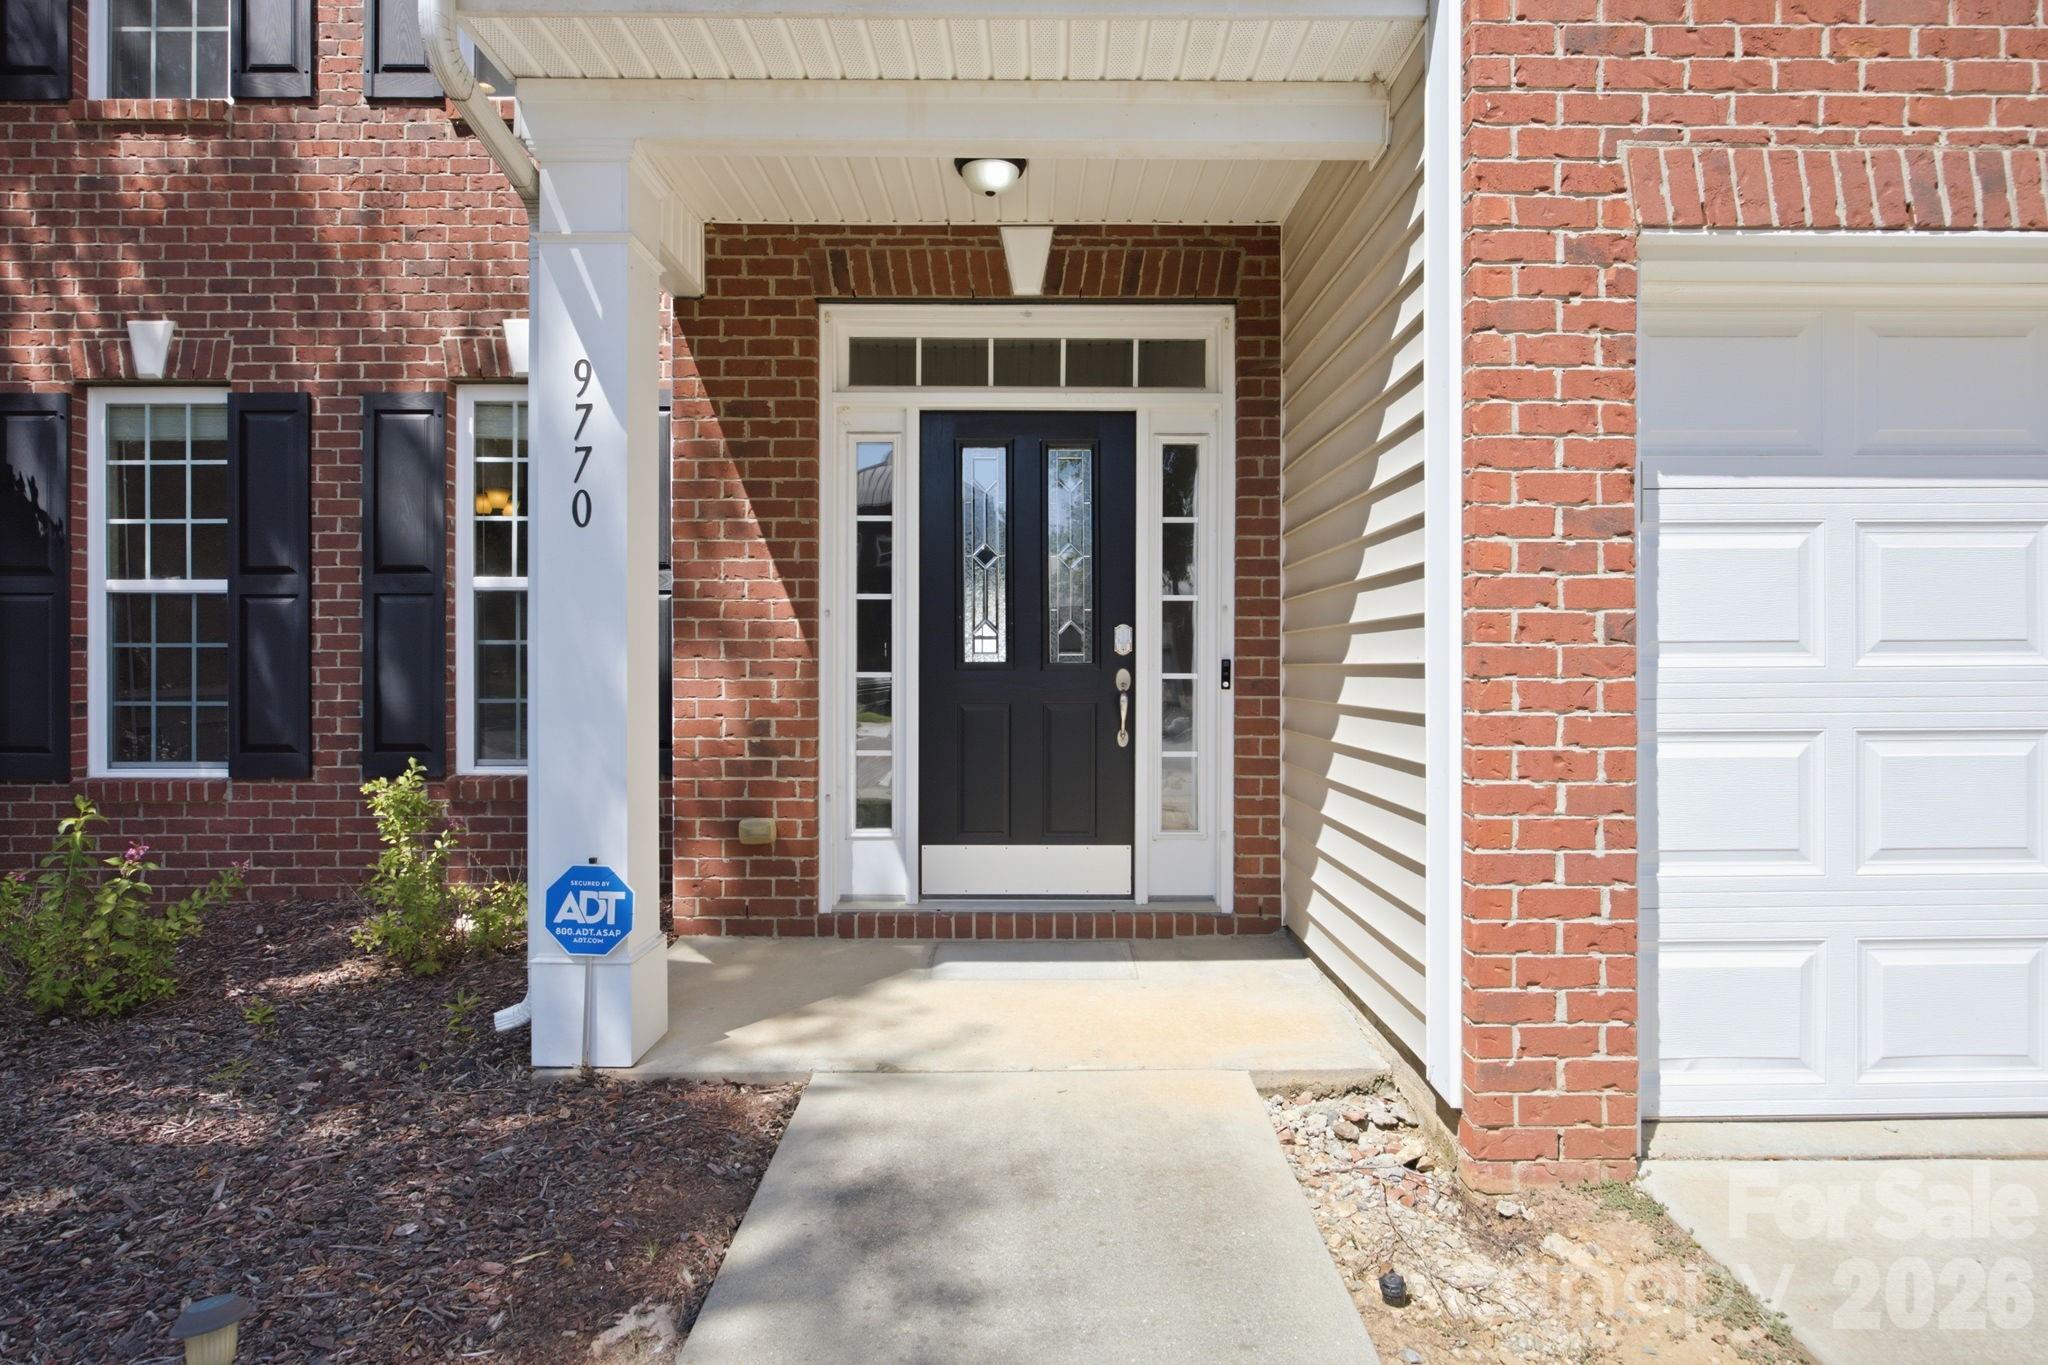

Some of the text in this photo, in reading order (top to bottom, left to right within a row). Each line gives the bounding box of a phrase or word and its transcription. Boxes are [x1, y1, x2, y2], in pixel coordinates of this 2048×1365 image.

[572, 359, 593, 528] 9770
[553, 890, 626, 925] ADT
[555, 927, 622, 937] 800.ADT.ASAP
